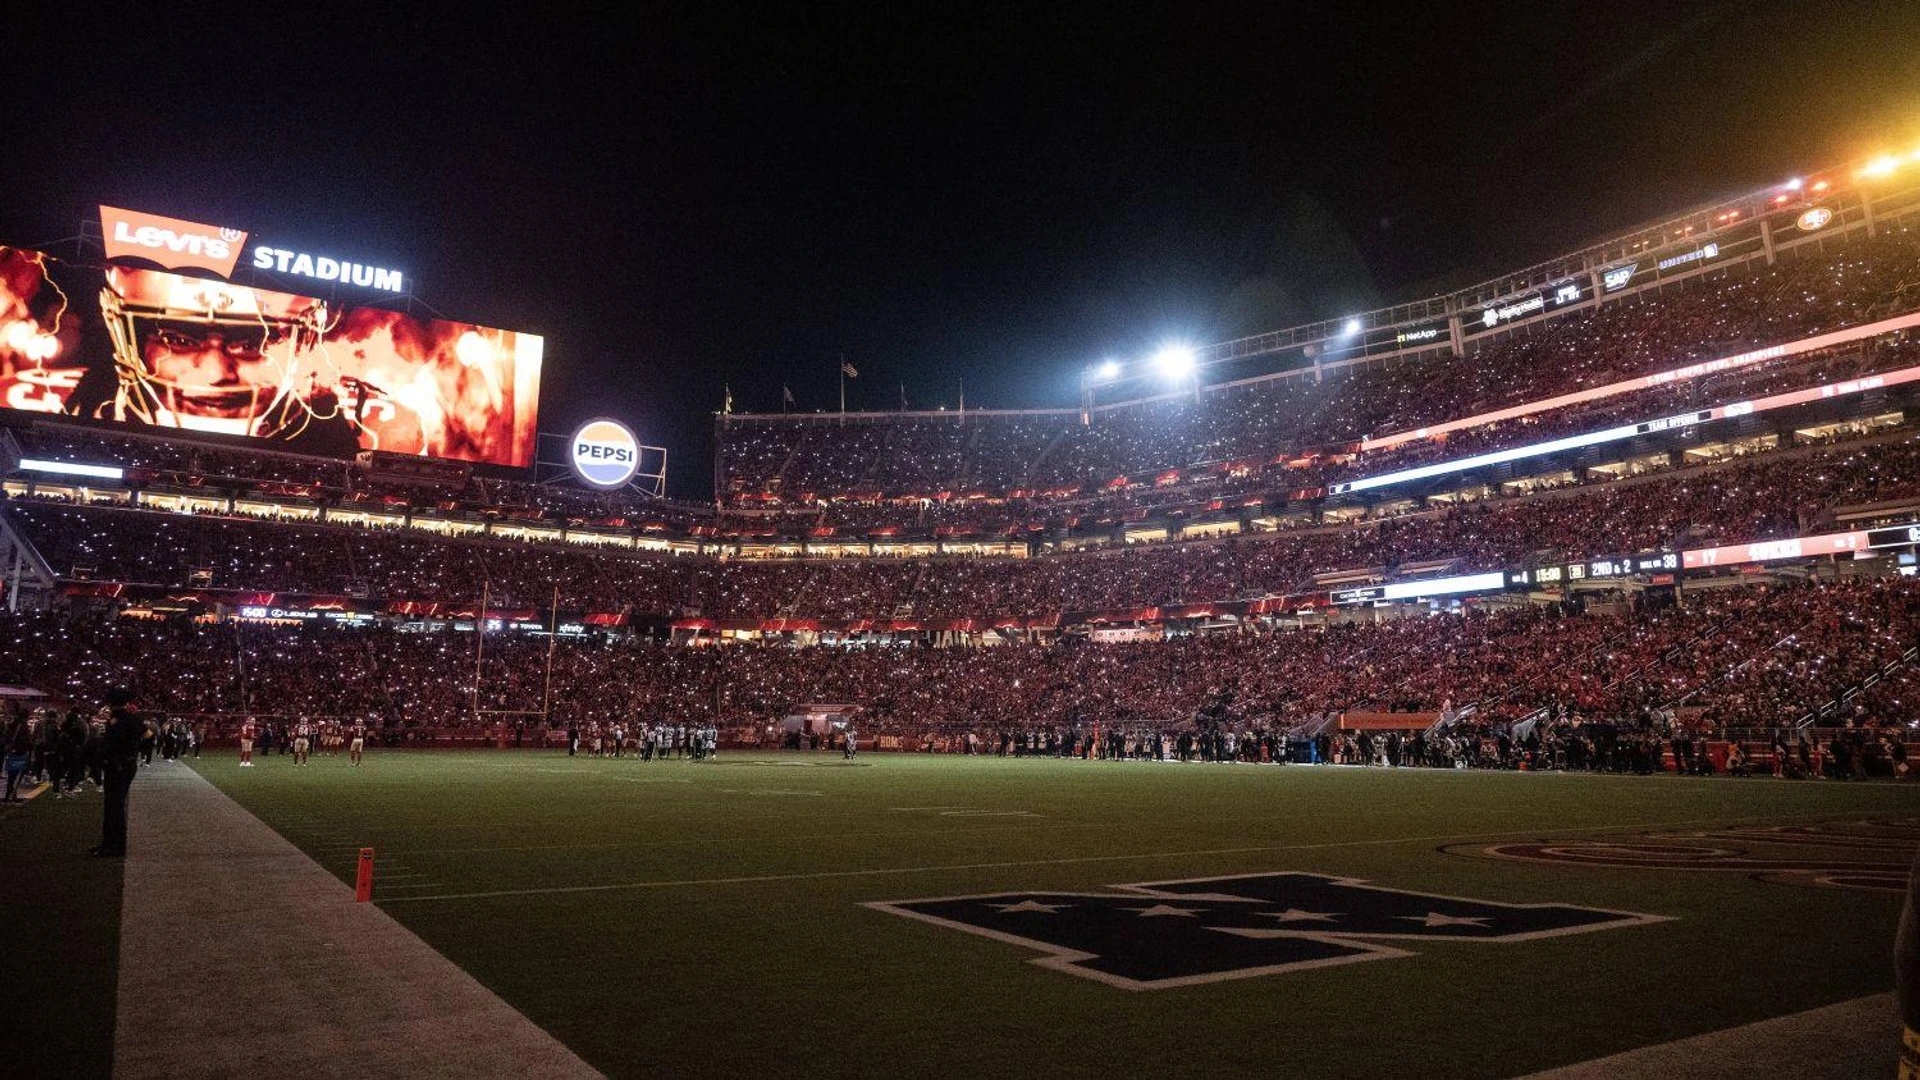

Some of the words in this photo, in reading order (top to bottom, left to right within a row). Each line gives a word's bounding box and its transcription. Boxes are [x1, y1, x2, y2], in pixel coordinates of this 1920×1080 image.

[254, 246, 402, 292] STADIUM
[1605, 270, 1629, 288] SAP
[1406, 329, 1437, 341] NetApp
[578, 444, 633, 462] PEPSI
[1592, 561, 1612, 576] 2ND
[1623, 560, 1631, 573] 2
[1663, 554, 1677, 568] 38
